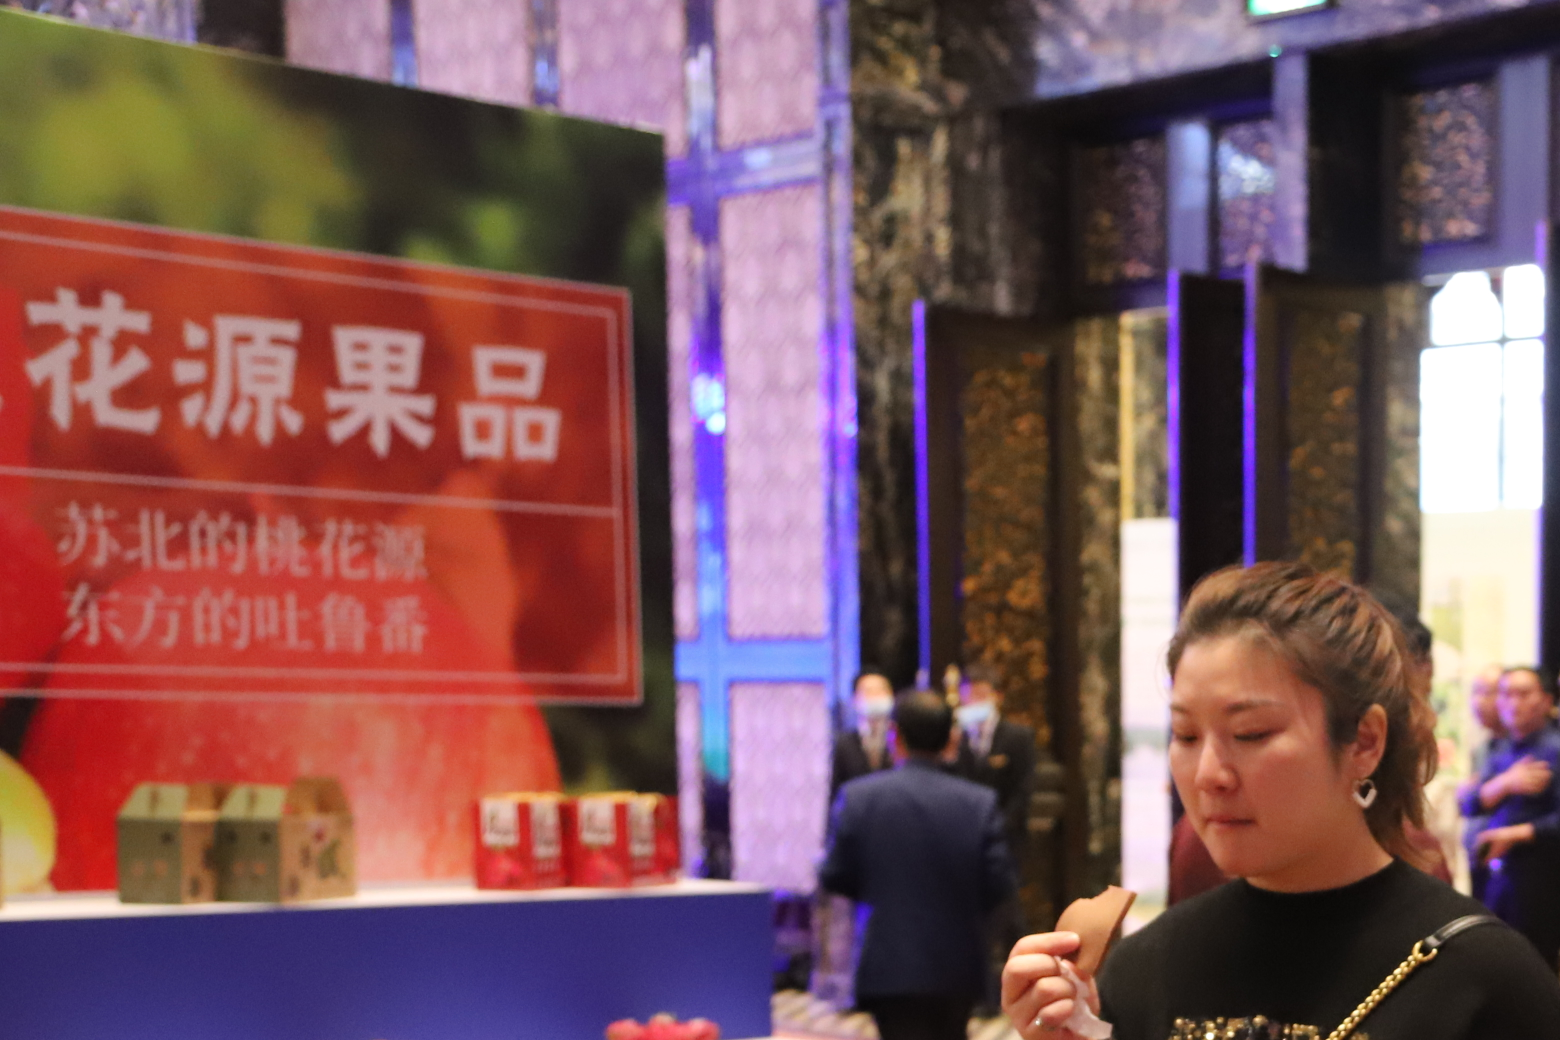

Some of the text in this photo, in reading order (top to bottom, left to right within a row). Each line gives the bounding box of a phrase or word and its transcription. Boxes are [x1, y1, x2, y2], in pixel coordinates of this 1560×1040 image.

[24, 286, 562, 463] 花源果品
[57, 500, 428, 583] 苏北的桃花源
[61, 583, 428, 655] 东方的吐鲁番
